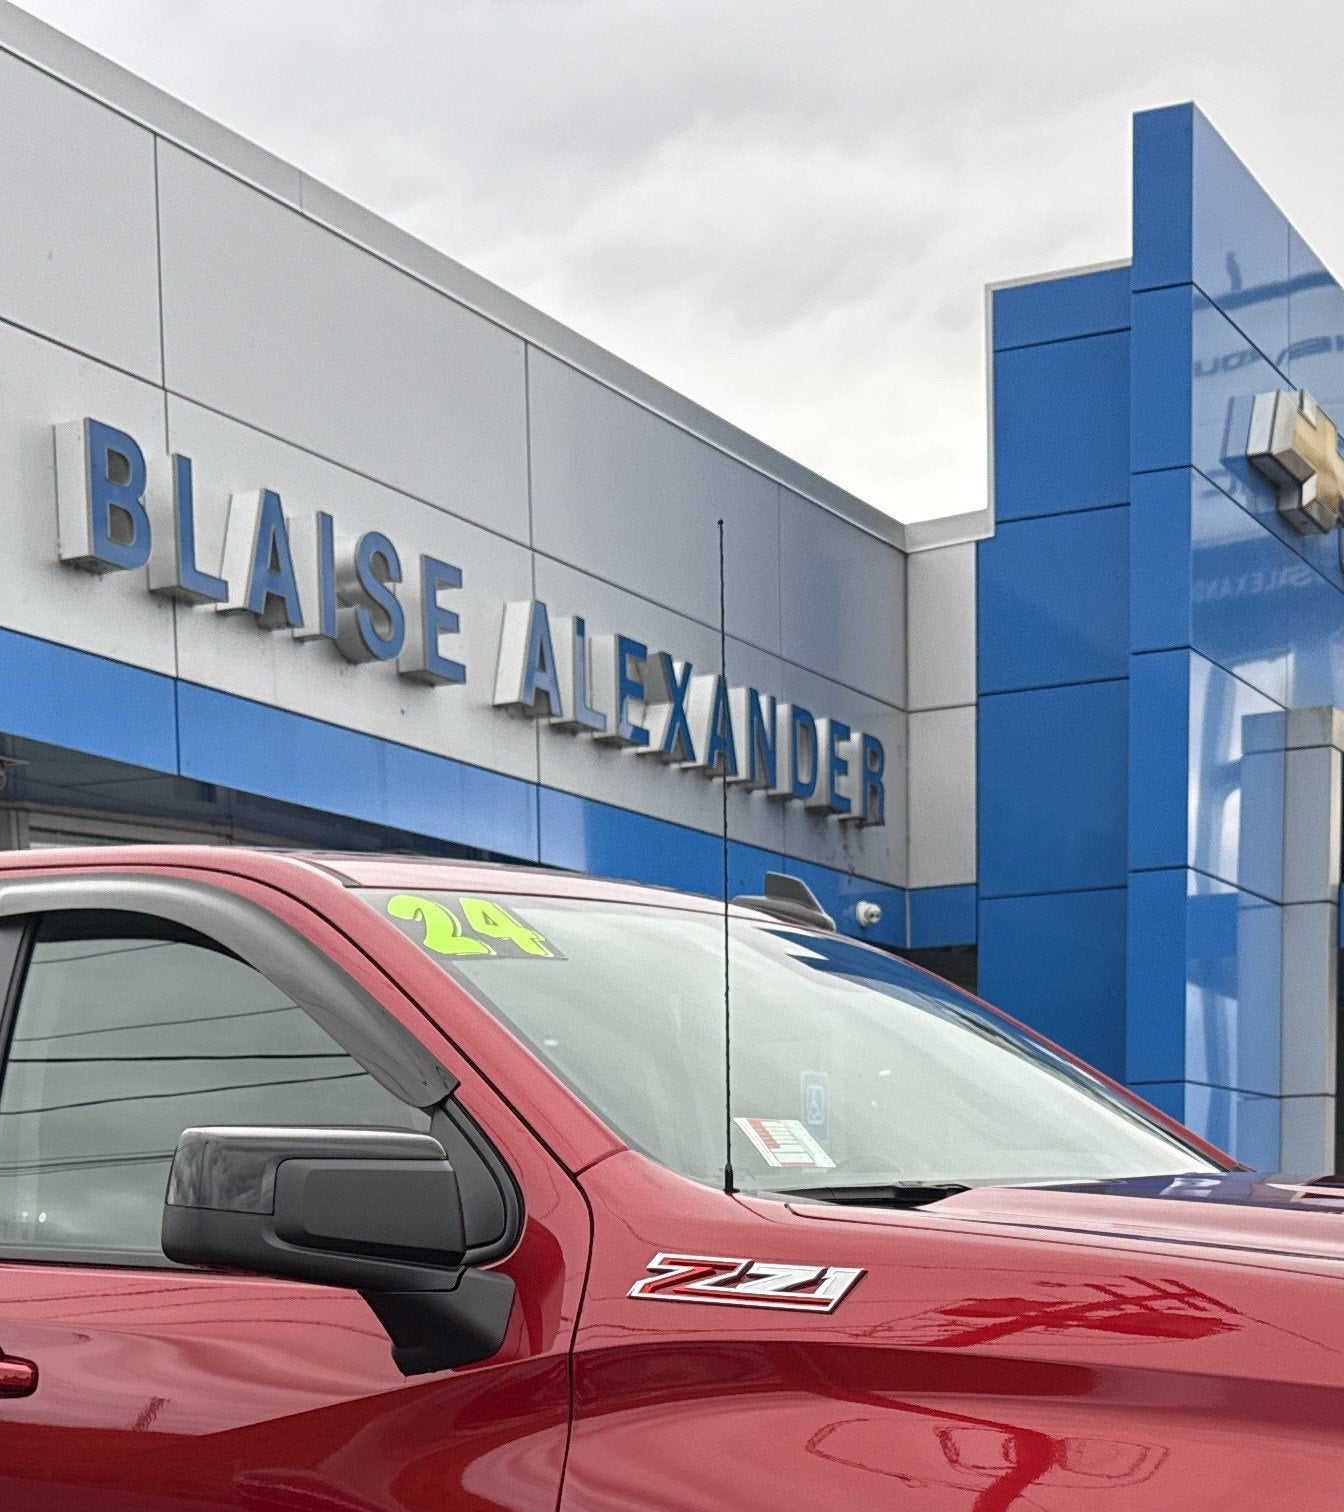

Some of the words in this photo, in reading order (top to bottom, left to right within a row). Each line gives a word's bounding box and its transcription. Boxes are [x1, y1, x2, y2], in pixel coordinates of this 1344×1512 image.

[58, 417, 467, 687] BLAISE
[496, 599, 888, 828] ALEXANDER
[386, 893, 554, 958] 24
[627, 1252, 867, 1315] Z71
